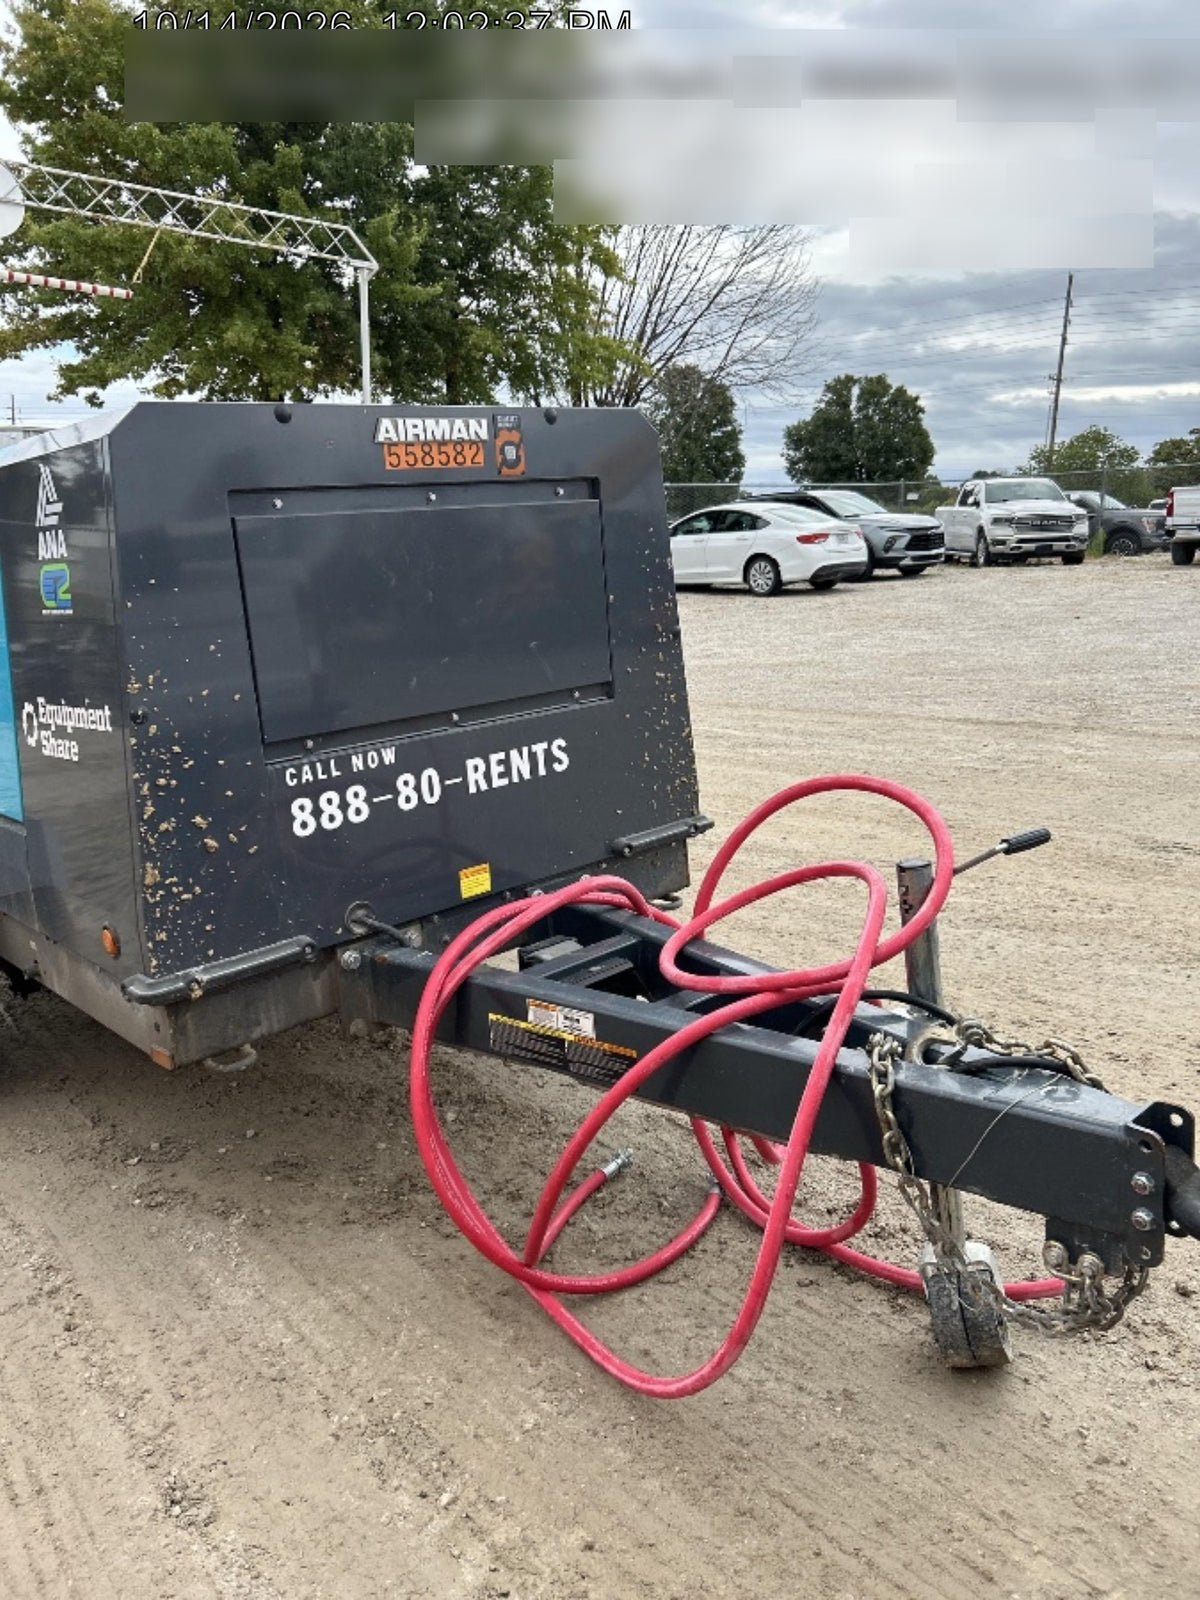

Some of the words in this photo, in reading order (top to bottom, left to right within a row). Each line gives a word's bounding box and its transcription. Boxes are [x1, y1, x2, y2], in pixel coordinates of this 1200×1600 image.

[376, 418, 488, 443] AIRMAN
[388, 443, 482, 468] 558582
[38, 530, 68, 561] ANA
[37, 697, 112, 733] Equipment
[41, 730, 79, 762] Share
[285, 759, 341, 786] CALL
[351, 747, 396, 772] NOW
[290, 737, 570, 837] 888-80-RENTS
